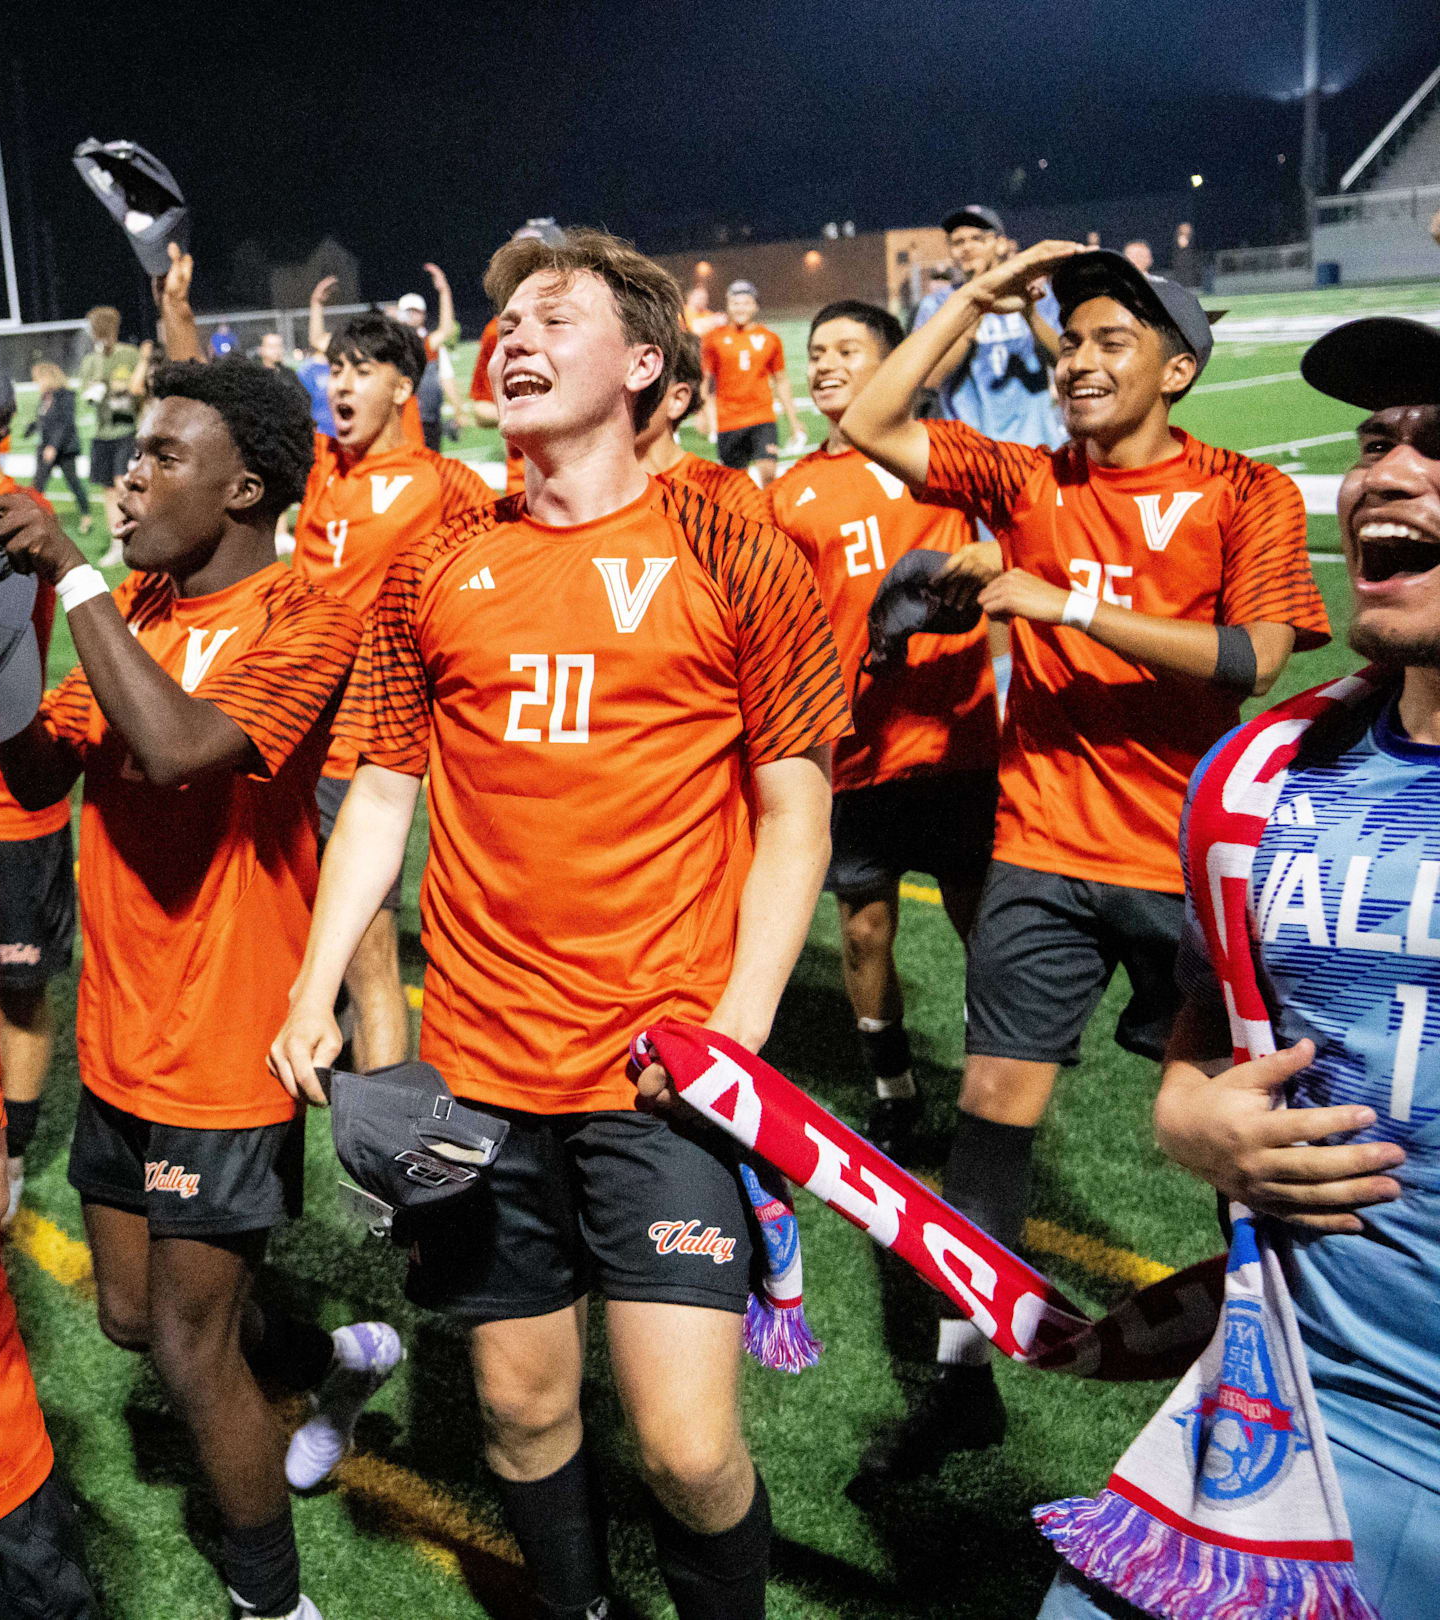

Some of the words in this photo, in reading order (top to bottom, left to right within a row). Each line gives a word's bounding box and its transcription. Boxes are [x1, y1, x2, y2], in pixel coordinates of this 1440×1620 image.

[370, 474, 415, 514] V
[1133, 491, 1204, 551] V
[326, 518, 349, 569] 4
[840, 514, 886, 577] 21
[592, 556, 678, 633] V
[181, 626, 240, 692] V
[503, 653, 595, 744] 20
[144, 1160, 201, 1199] Valley
[648, 1219, 737, 1264] Valley
